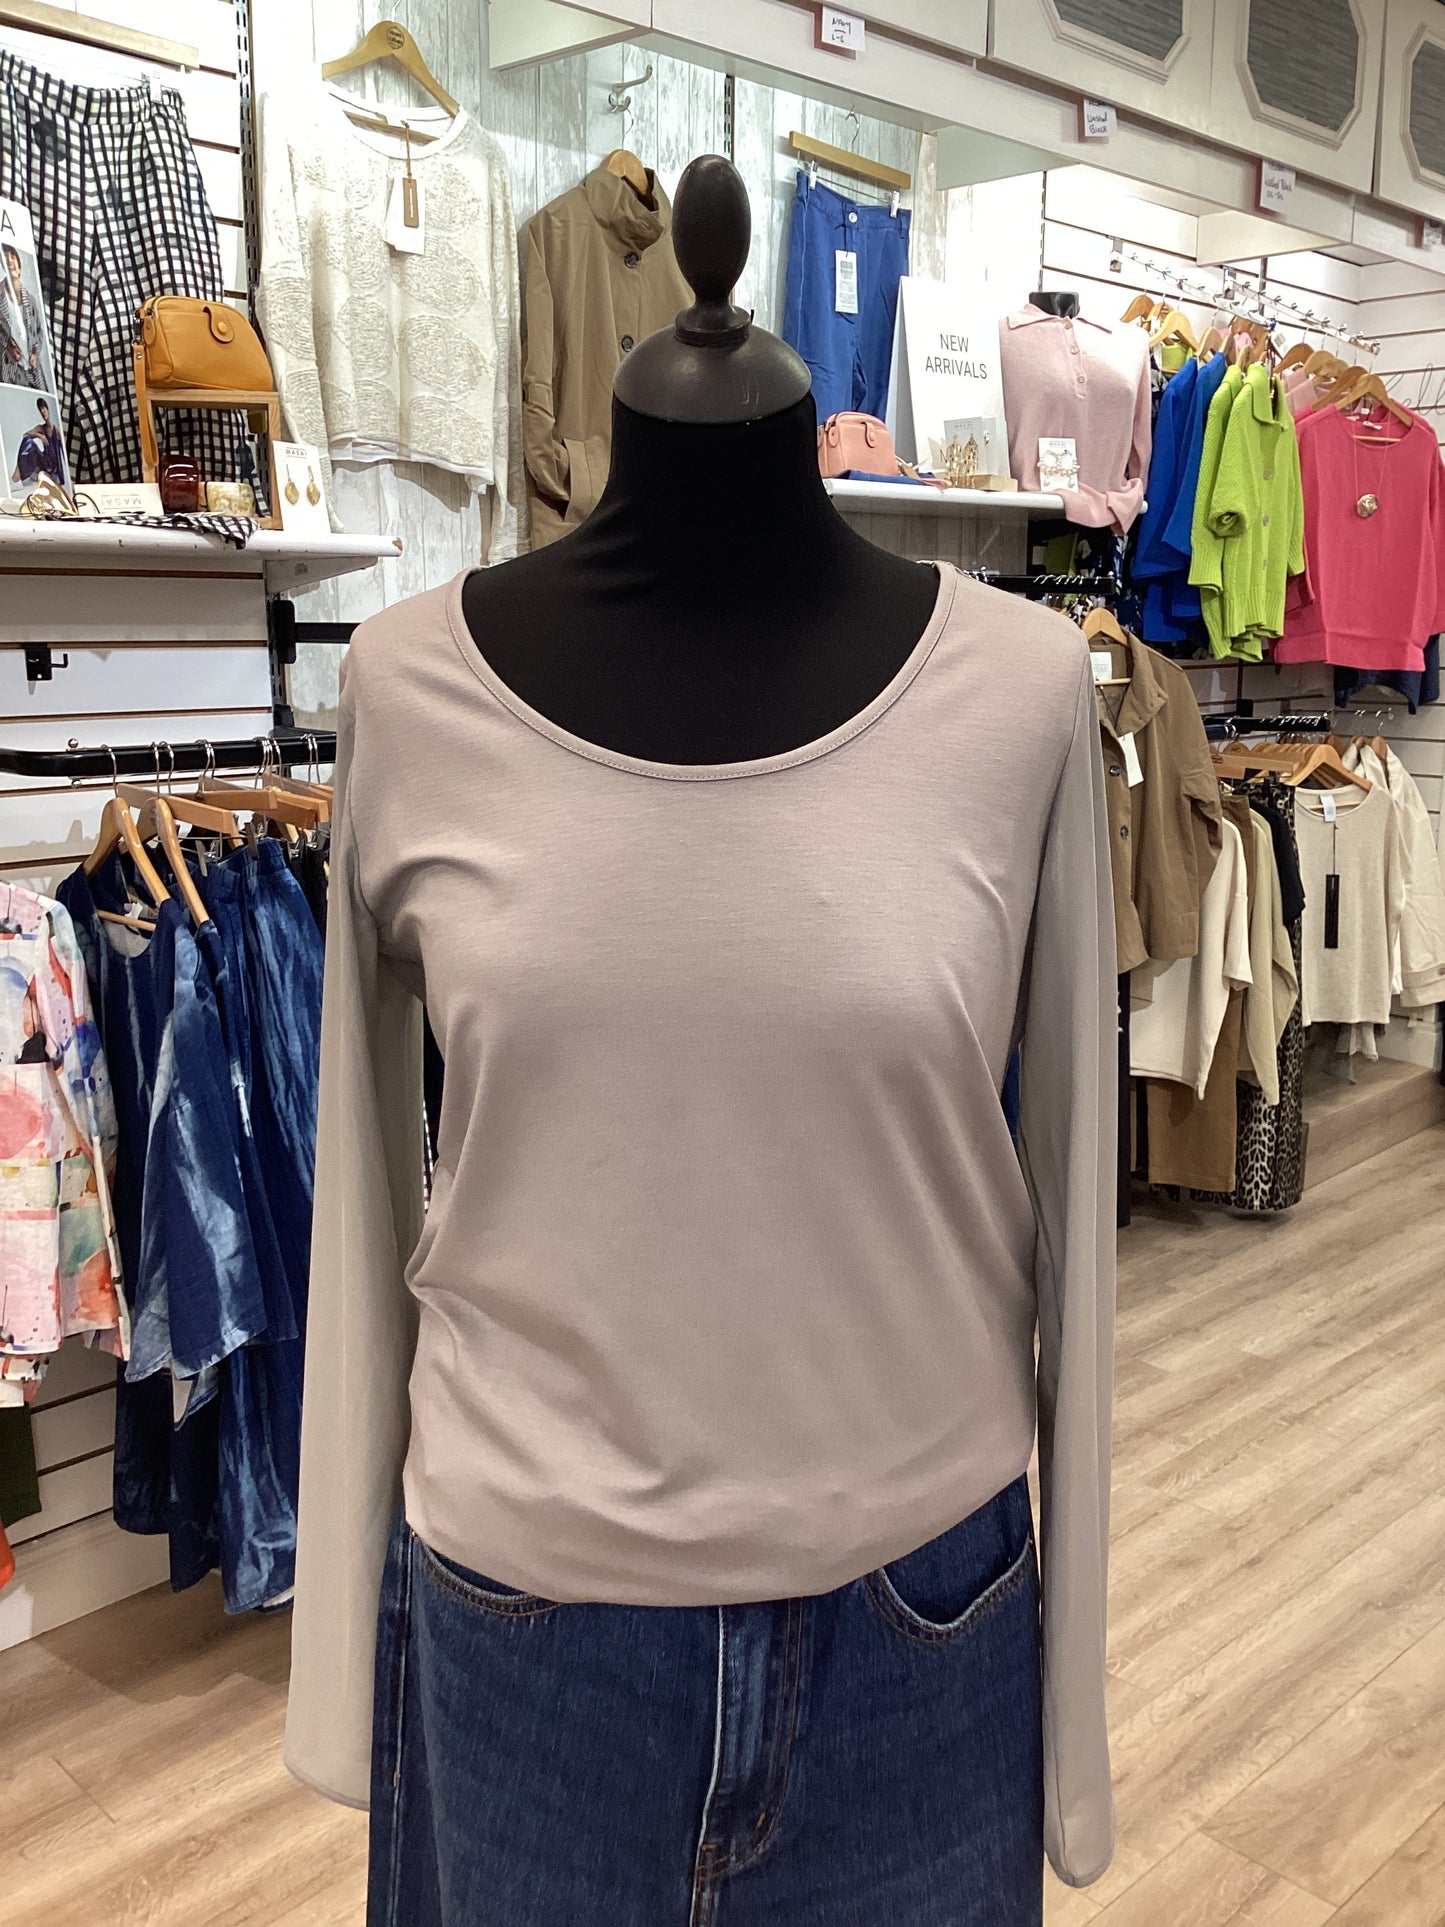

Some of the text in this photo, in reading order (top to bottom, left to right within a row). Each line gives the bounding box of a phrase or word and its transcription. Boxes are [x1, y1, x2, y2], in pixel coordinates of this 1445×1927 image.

[940, 333, 969, 353] NEW
[925, 356, 988, 380] ARRIVALS
[101, 497, 142, 506] MASAI
